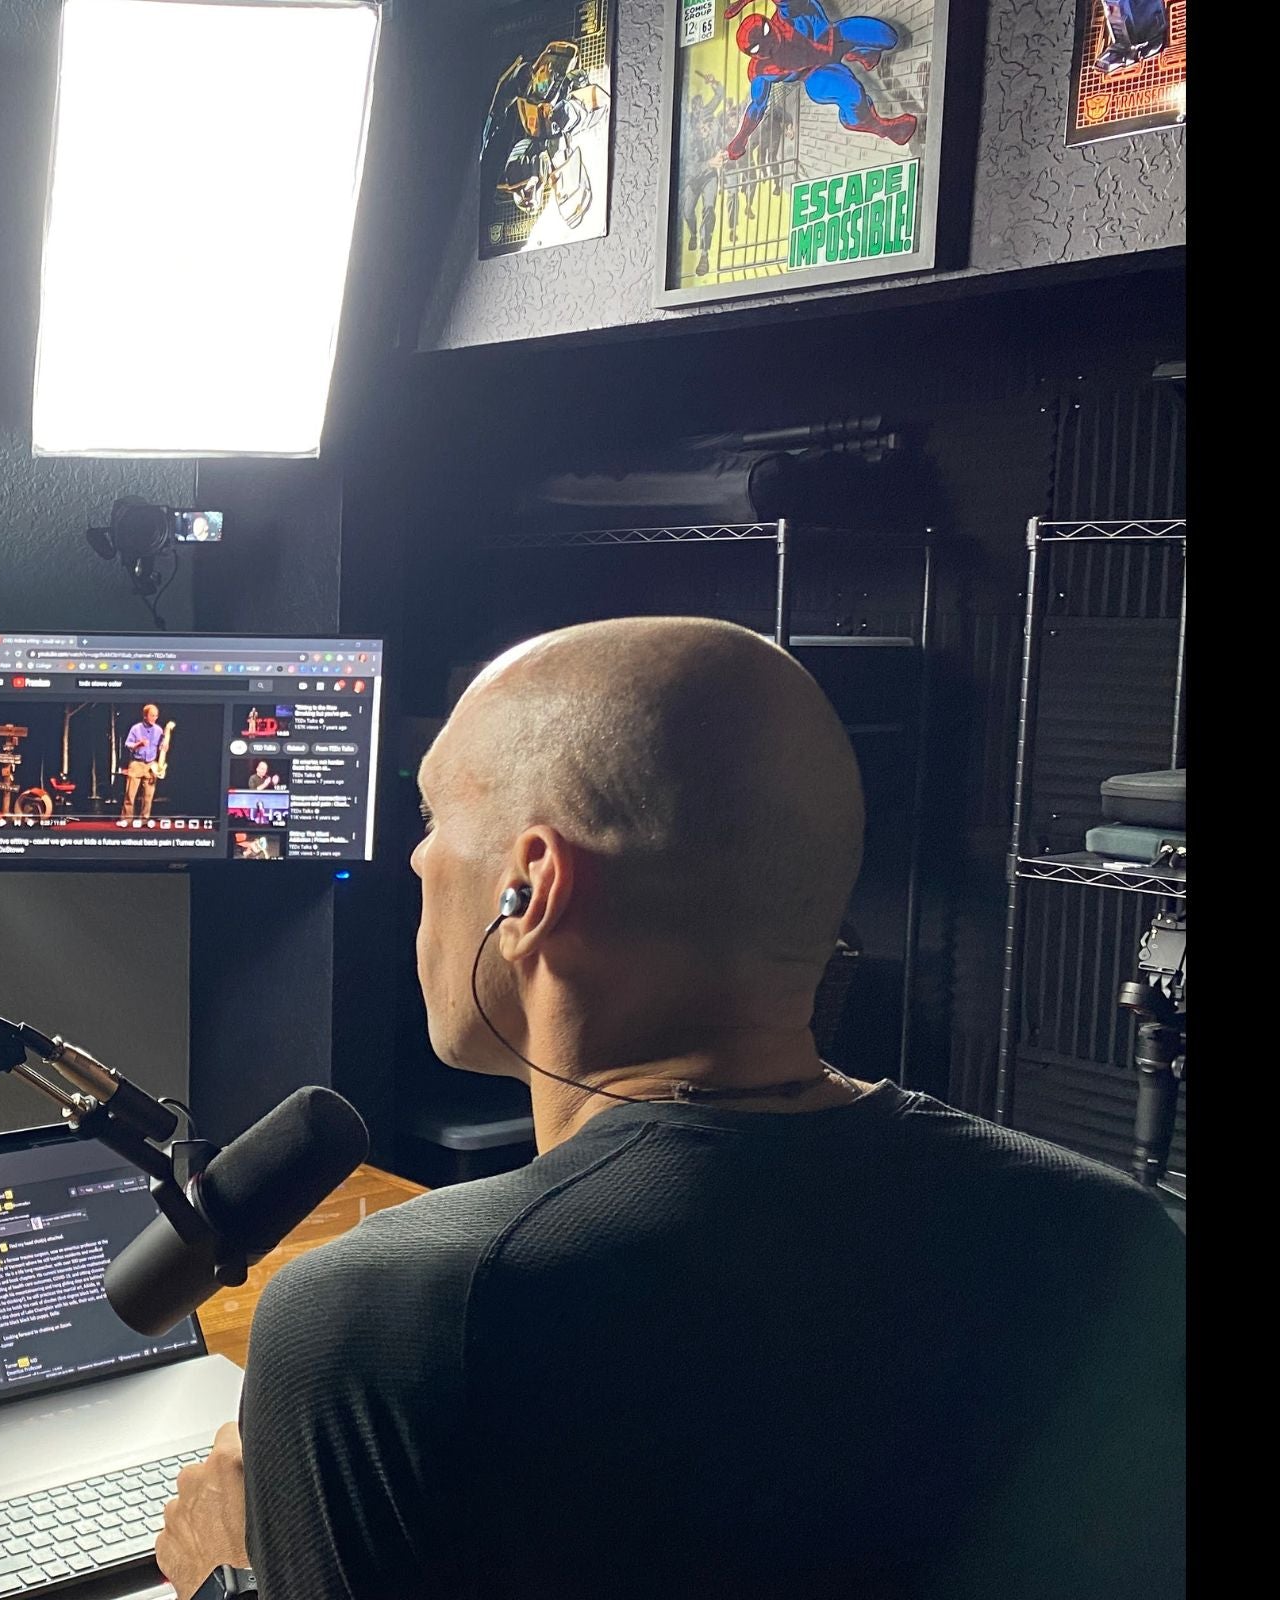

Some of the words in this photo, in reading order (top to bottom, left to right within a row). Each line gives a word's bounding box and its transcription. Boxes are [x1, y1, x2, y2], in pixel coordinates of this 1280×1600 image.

[685, 9, 712, 21] GROUP
[790, 174, 916, 268] IMPOSSIBLE!
[793, 165, 902, 228] ESCAPE
